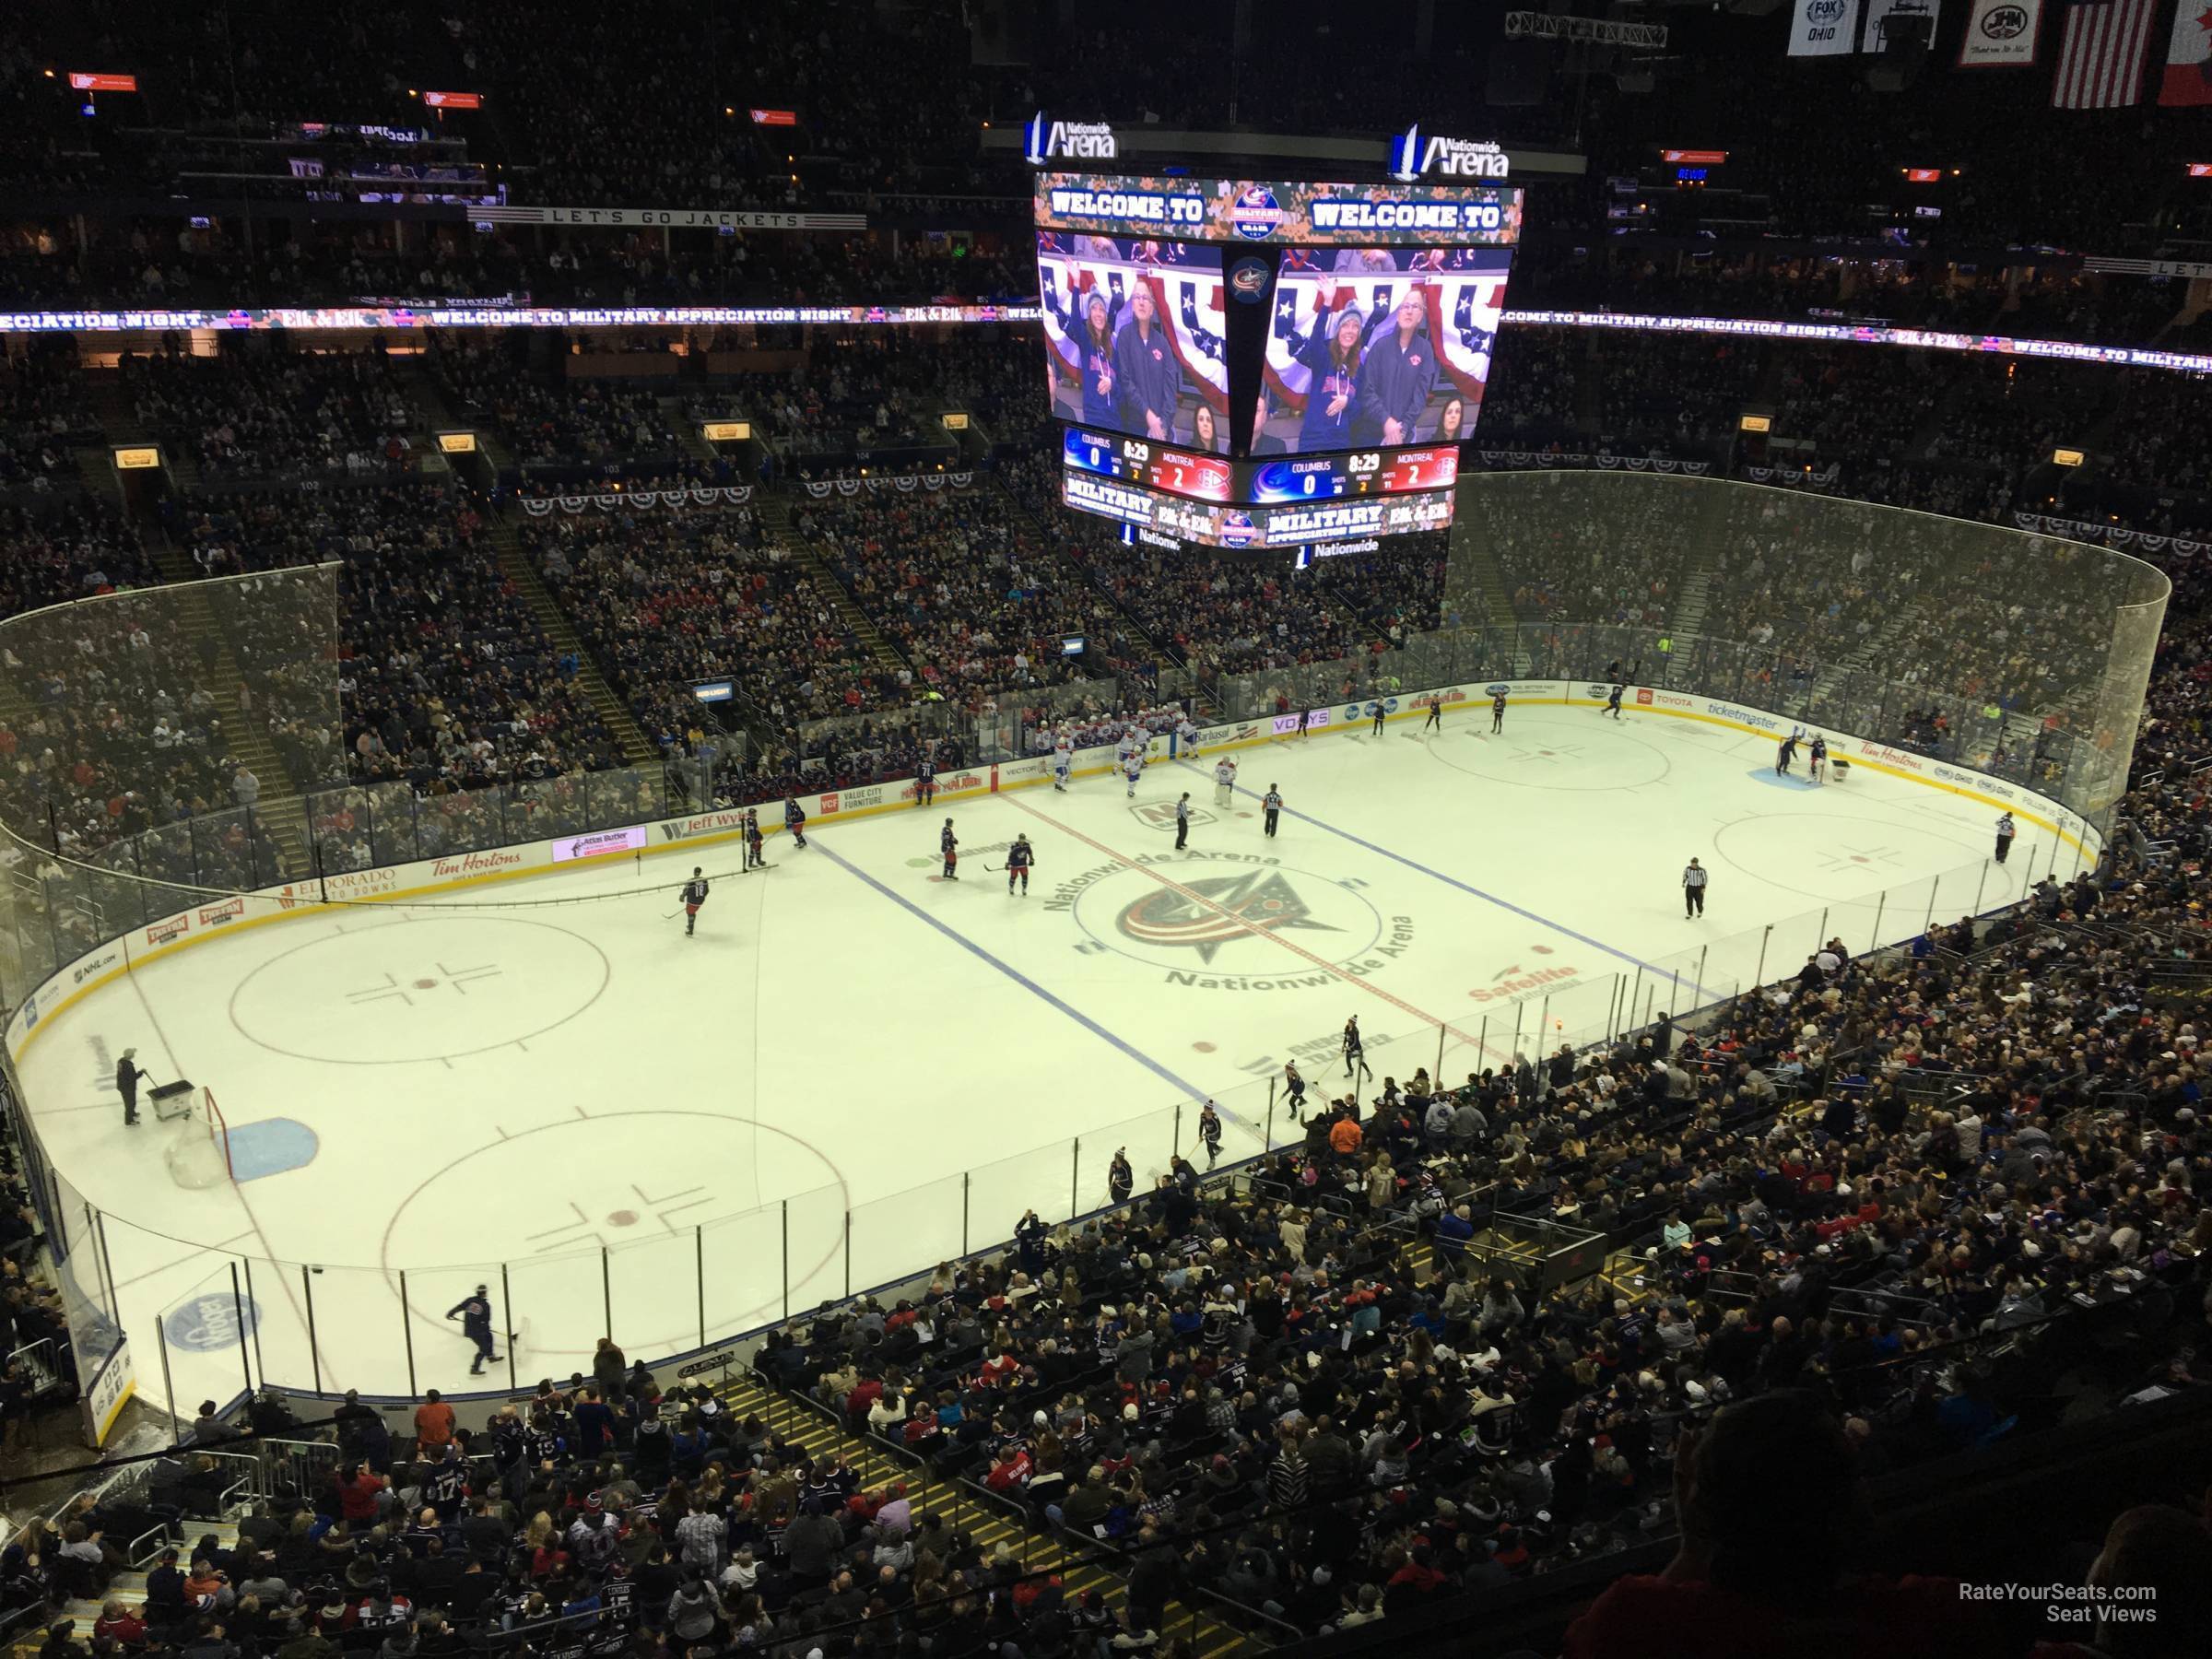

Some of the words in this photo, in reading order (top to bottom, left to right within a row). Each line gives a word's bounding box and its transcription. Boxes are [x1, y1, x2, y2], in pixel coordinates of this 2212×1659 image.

[1988, 12, 2021, 30] JHM
[1808, 28, 1835, 41] OHIO
[1067, 122, 1110, 135] Nationwide
[1046, 121, 1115, 159] Arena
[1446, 137, 1500, 154] Nationwide
[1420, 136, 1510, 178] Arena
[1052, 191, 1165, 219] WELCOME
[1169, 197, 1204, 222] TO
[1312, 203, 1458, 227] WELCOME
[1465, 206, 1500, 228] TO
[553, 210, 623, 223] LET'S
[642, 212, 672, 225] GO
[686, 213, 798, 227] JACKETS
[125, 312, 202, 327] NIGHT
[283, 310, 312, 327] Elk
[316, 315, 333, 328] &
[335, 309, 365, 327] Elk
[431, 311, 534, 324] WELCOME
[538, 310, 563, 323] TO
[569, 310, 661, 323] MILITARY
[664, 310, 795, 323] APPRECIATION
[800, 310, 852, 321] NIGHT
[905, 308, 927, 322] Elk
[927, 308, 938, 321] &
[941, 308, 962, 322] Elk
[1554, 312, 1575, 324] TO
[1578, 313, 1656, 327] MILITARY
[1657, 317, 1782, 335] APPRECIATION
[1785, 323, 1839, 337] NIGHT
[1896, 333, 1919, 346] Elk
[1921, 335, 1936, 347] &
[1936, 334, 1959, 348] Elk
[2014, 340, 2100, 358] WELCOME
[2104, 347, 2128, 360] TO
[1081, 433, 1112, 449] COLUMBUS
[1124, 440, 1149, 461] 8:29
[1090, 447, 1100, 466] 0
[605, 465, 619, 474] 103
[1162, 452, 1195, 468] MONTREAL
[1291, 460, 1332, 474] COLUMBUS
[1348, 453, 1381, 473] 8:29
[1396, 452, 1434, 465] MONTREAL
[1132, 469, 1139, 479] 2
[1173, 467, 1182, 488] 2
[1303, 475, 1316, 495] 0
[1408, 465, 1419, 484] 2
[1067, 477, 1153, 514] MILITARY
[1359, 481, 1367, 492] 2
[1066, 494, 1124, 517] APPRECIATION
[1125, 509, 1152, 524] NIGHT
[1389, 507, 1413, 524] Elk
[1413, 505, 1429, 520] &
[1428, 501, 1448, 521] Elk
[1158, 506, 1178, 526] Elk
[1179, 511, 1190, 529] &
[1191, 514, 1213, 535] Elk
[1267, 505, 1383, 534] MILITARY
[1266, 526, 1347, 543] APPRECIATION
[1348, 523, 1382, 535] NIGHT
[1314, 538, 1380, 558] Nationwide
[1656, 694, 1693, 709] TOYOTA
[1274, 712, 1328, 731] VOYS
[1707, 702, 1778, 731] ticketmaster
[1861, 741, 1880, 757] Tim
[1880, 746, 1923, 770] Hortons
[922, 767, 931, 777] 71
[1006, 765, 1036, 776] VECTOR
[1954, 773, 1973, 784] OHIO
[821, 797, 839, 810] VCF
[844, 789, 865, 801] VALUE
[866, 787, 882, 798] CITY
[844, 796, 883, 809] FURNITURE
[688, 815, 714, 831] Jeff
[582, 836, 603, 846] Atlas
[604, 831, 628, 841] Butler
[430, 857, 460, 877] Tim
[462, 851, 521, 873] Hortons
[353, 881, 397, 896] DOWNS
[1043, 853, 1172, 912] Nationwide
[1186, 849, 1282, 866] Arena
[1164, 959, 1382, 993] Nationwide
[1380, 914, 1415, 959] Arena
[1468, 966, 1579, 1002] Safelite
[1287, 1031, 1346, 1056] ENERG
[536, 1440, 555, 1457] 15
[437, 1477, 457, 1502] 17
